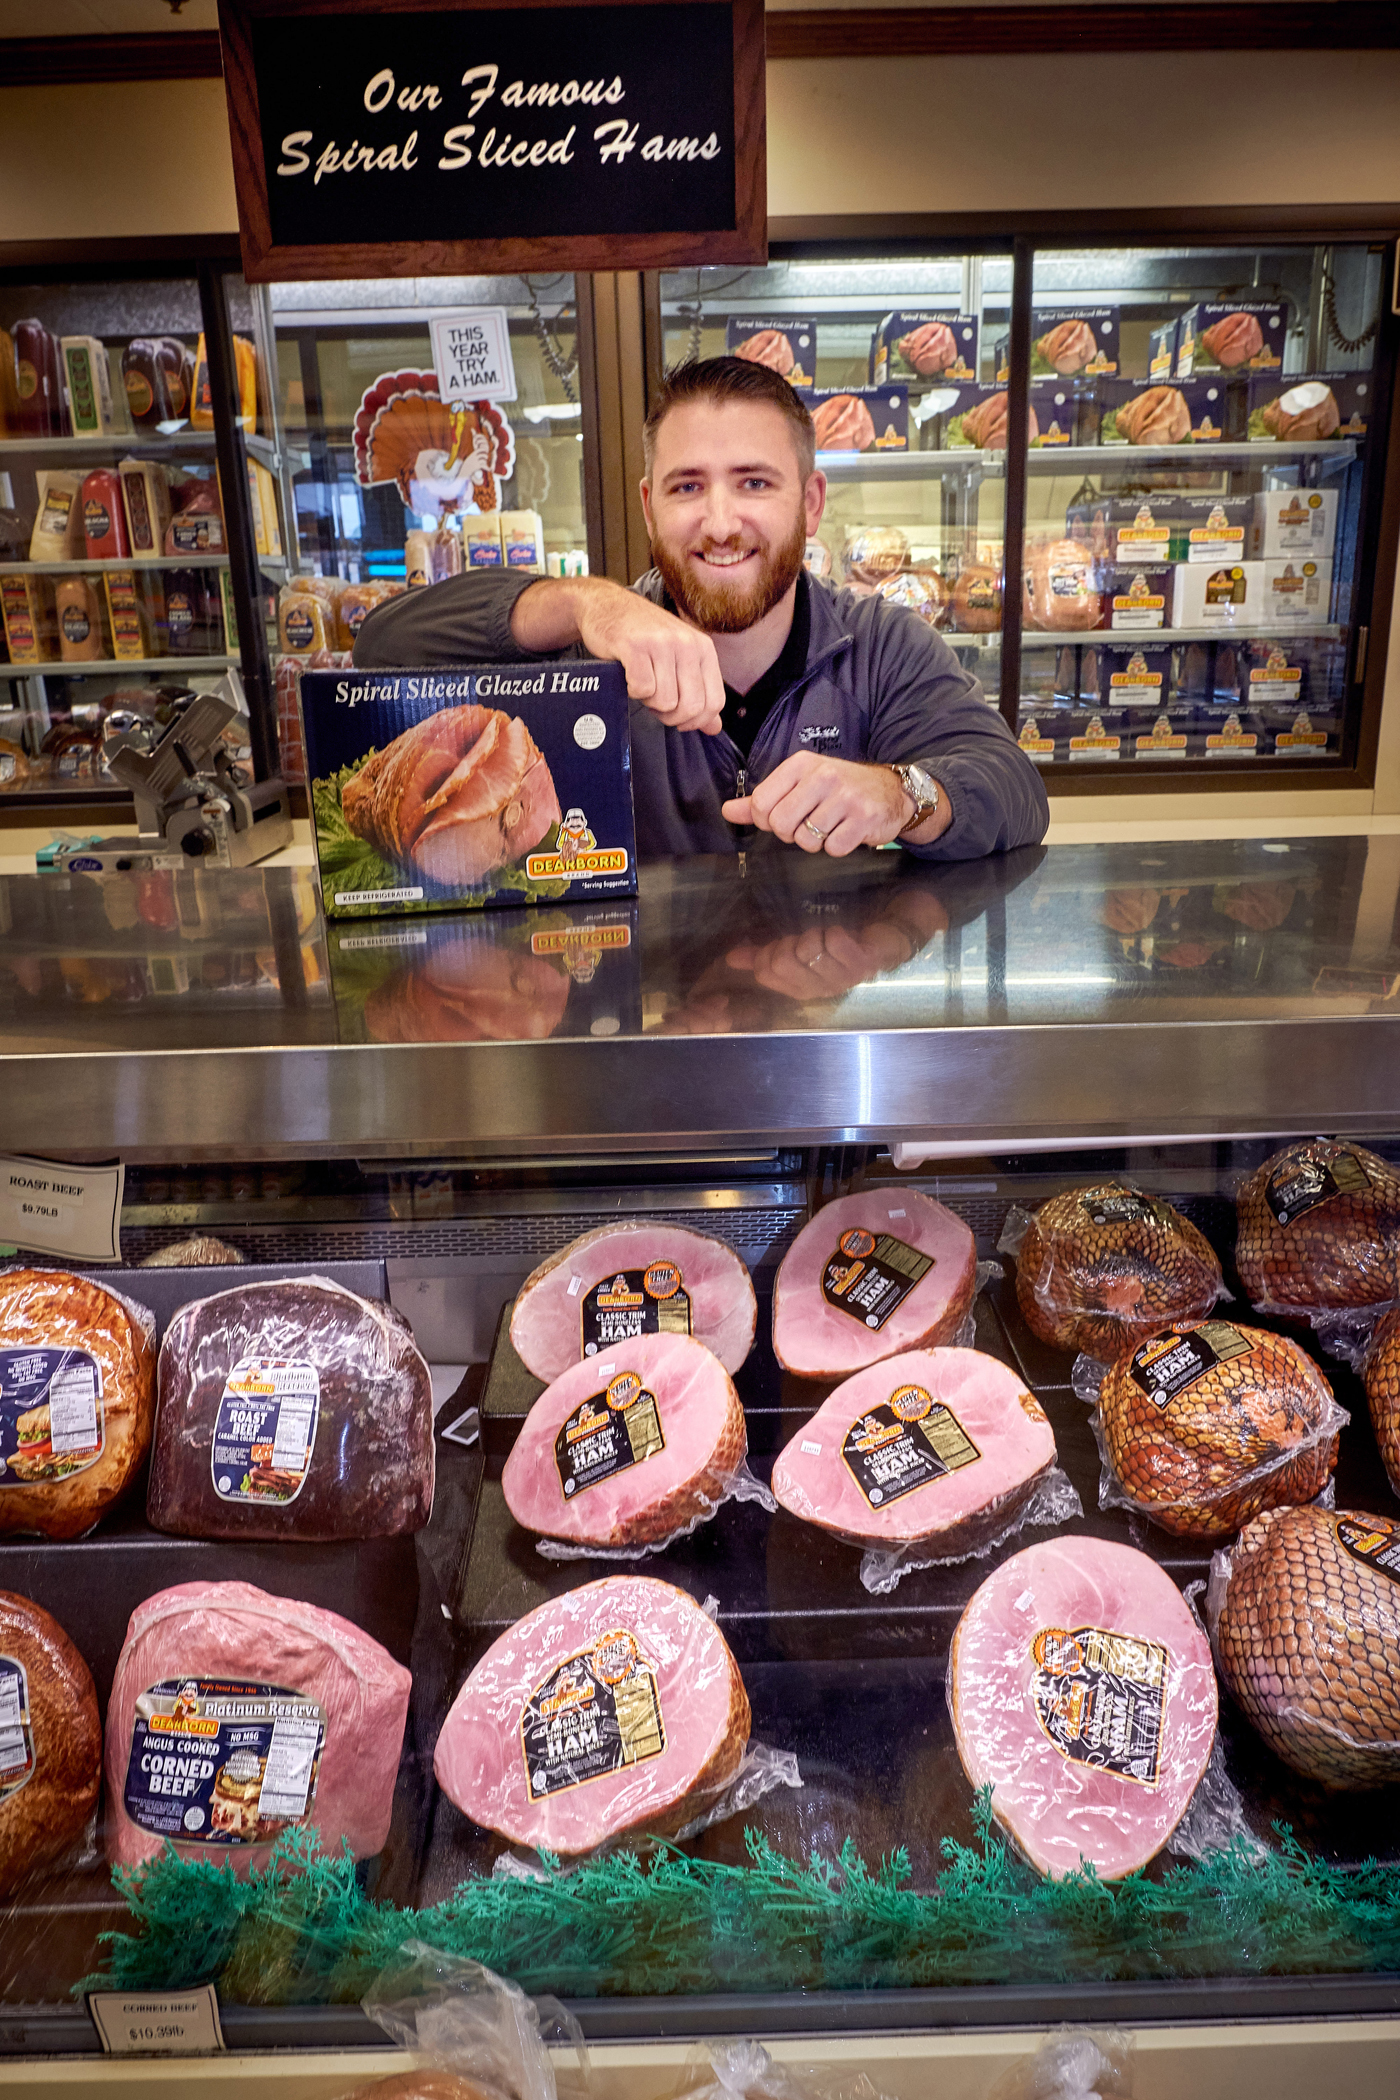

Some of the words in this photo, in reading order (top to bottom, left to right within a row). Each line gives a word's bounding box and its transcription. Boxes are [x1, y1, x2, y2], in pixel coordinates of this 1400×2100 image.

[363, 68, 442, 114] Our
[461, 63, 626, 119] Famous
[277, 130, 418, 185] Spiral
[438, 124, 576, 170] Sliced
[594, 118, 721, 164] Hams
[448, 325, 483, 343] THIS
[449, 341, 489, 358] YEAR
[456, 357, 486, 373] TRY
[449, 375, 459, 389] A
[462, 370, 500, 388] HAM.
[335, 680, 400, 707] Spiral
[406, 676, 470, 700] Sliced
[475, 673, 545, 697] Glazed
[550, 672, 600, 693] Ham
[533, 854, 622, 874] DEARBORN
[9, 1176, 49, 1190] ROAST
[52, 1182, 84, 1196] BEEF
[22, 1203, 58, 1217] $9.79LB
[861, 1276, 889, 1307] HAM
[596, 1312, 627, 1321] CLASSIC
[628, 1311, 646, 1320] TRIM
[601, 1325, 641, 1337] HAM
[1146, 1353, 1174, 1377] CLASSIC
[1156, 1351, 1196, 1383] HAM
[229, 1409, 268, 1425] ROAST
[232, 1422, 260, 1438] BEEF
[256, 1436, 273, 1444] ADDED
[599, 1426, 615, 1441] TRIM
[573, 1442, 614, 1468] HAM
[863, 1443, 896, 1466] CLASSIC
[896, 1437, 914, 1450] TRIM
[872, 1449, 919, 1480] HAM
[205, 1701, 265, 1716] Platinum
[268, 1702, 320, 1718] Reserve
[152, 1716, 216, 1734] DEARBORN
[1110, 1696, 1129, 1755] HAM
[143, 1735, 174, 1751] ANGUS
[177, 1740, 220, 1756] COOKED
[230, 1733, 242, 1742] NO
[242, 1731, 259, 1741] MSG
[547, 1727, 598, 1757] HAM
[141, 1753, 214, 1780] CORNED
[149, 1774, 196, 1797] BEEF
[123, 2004, 167, 2013] CORNED
[170, 2003, 198, 2013] BEEF
